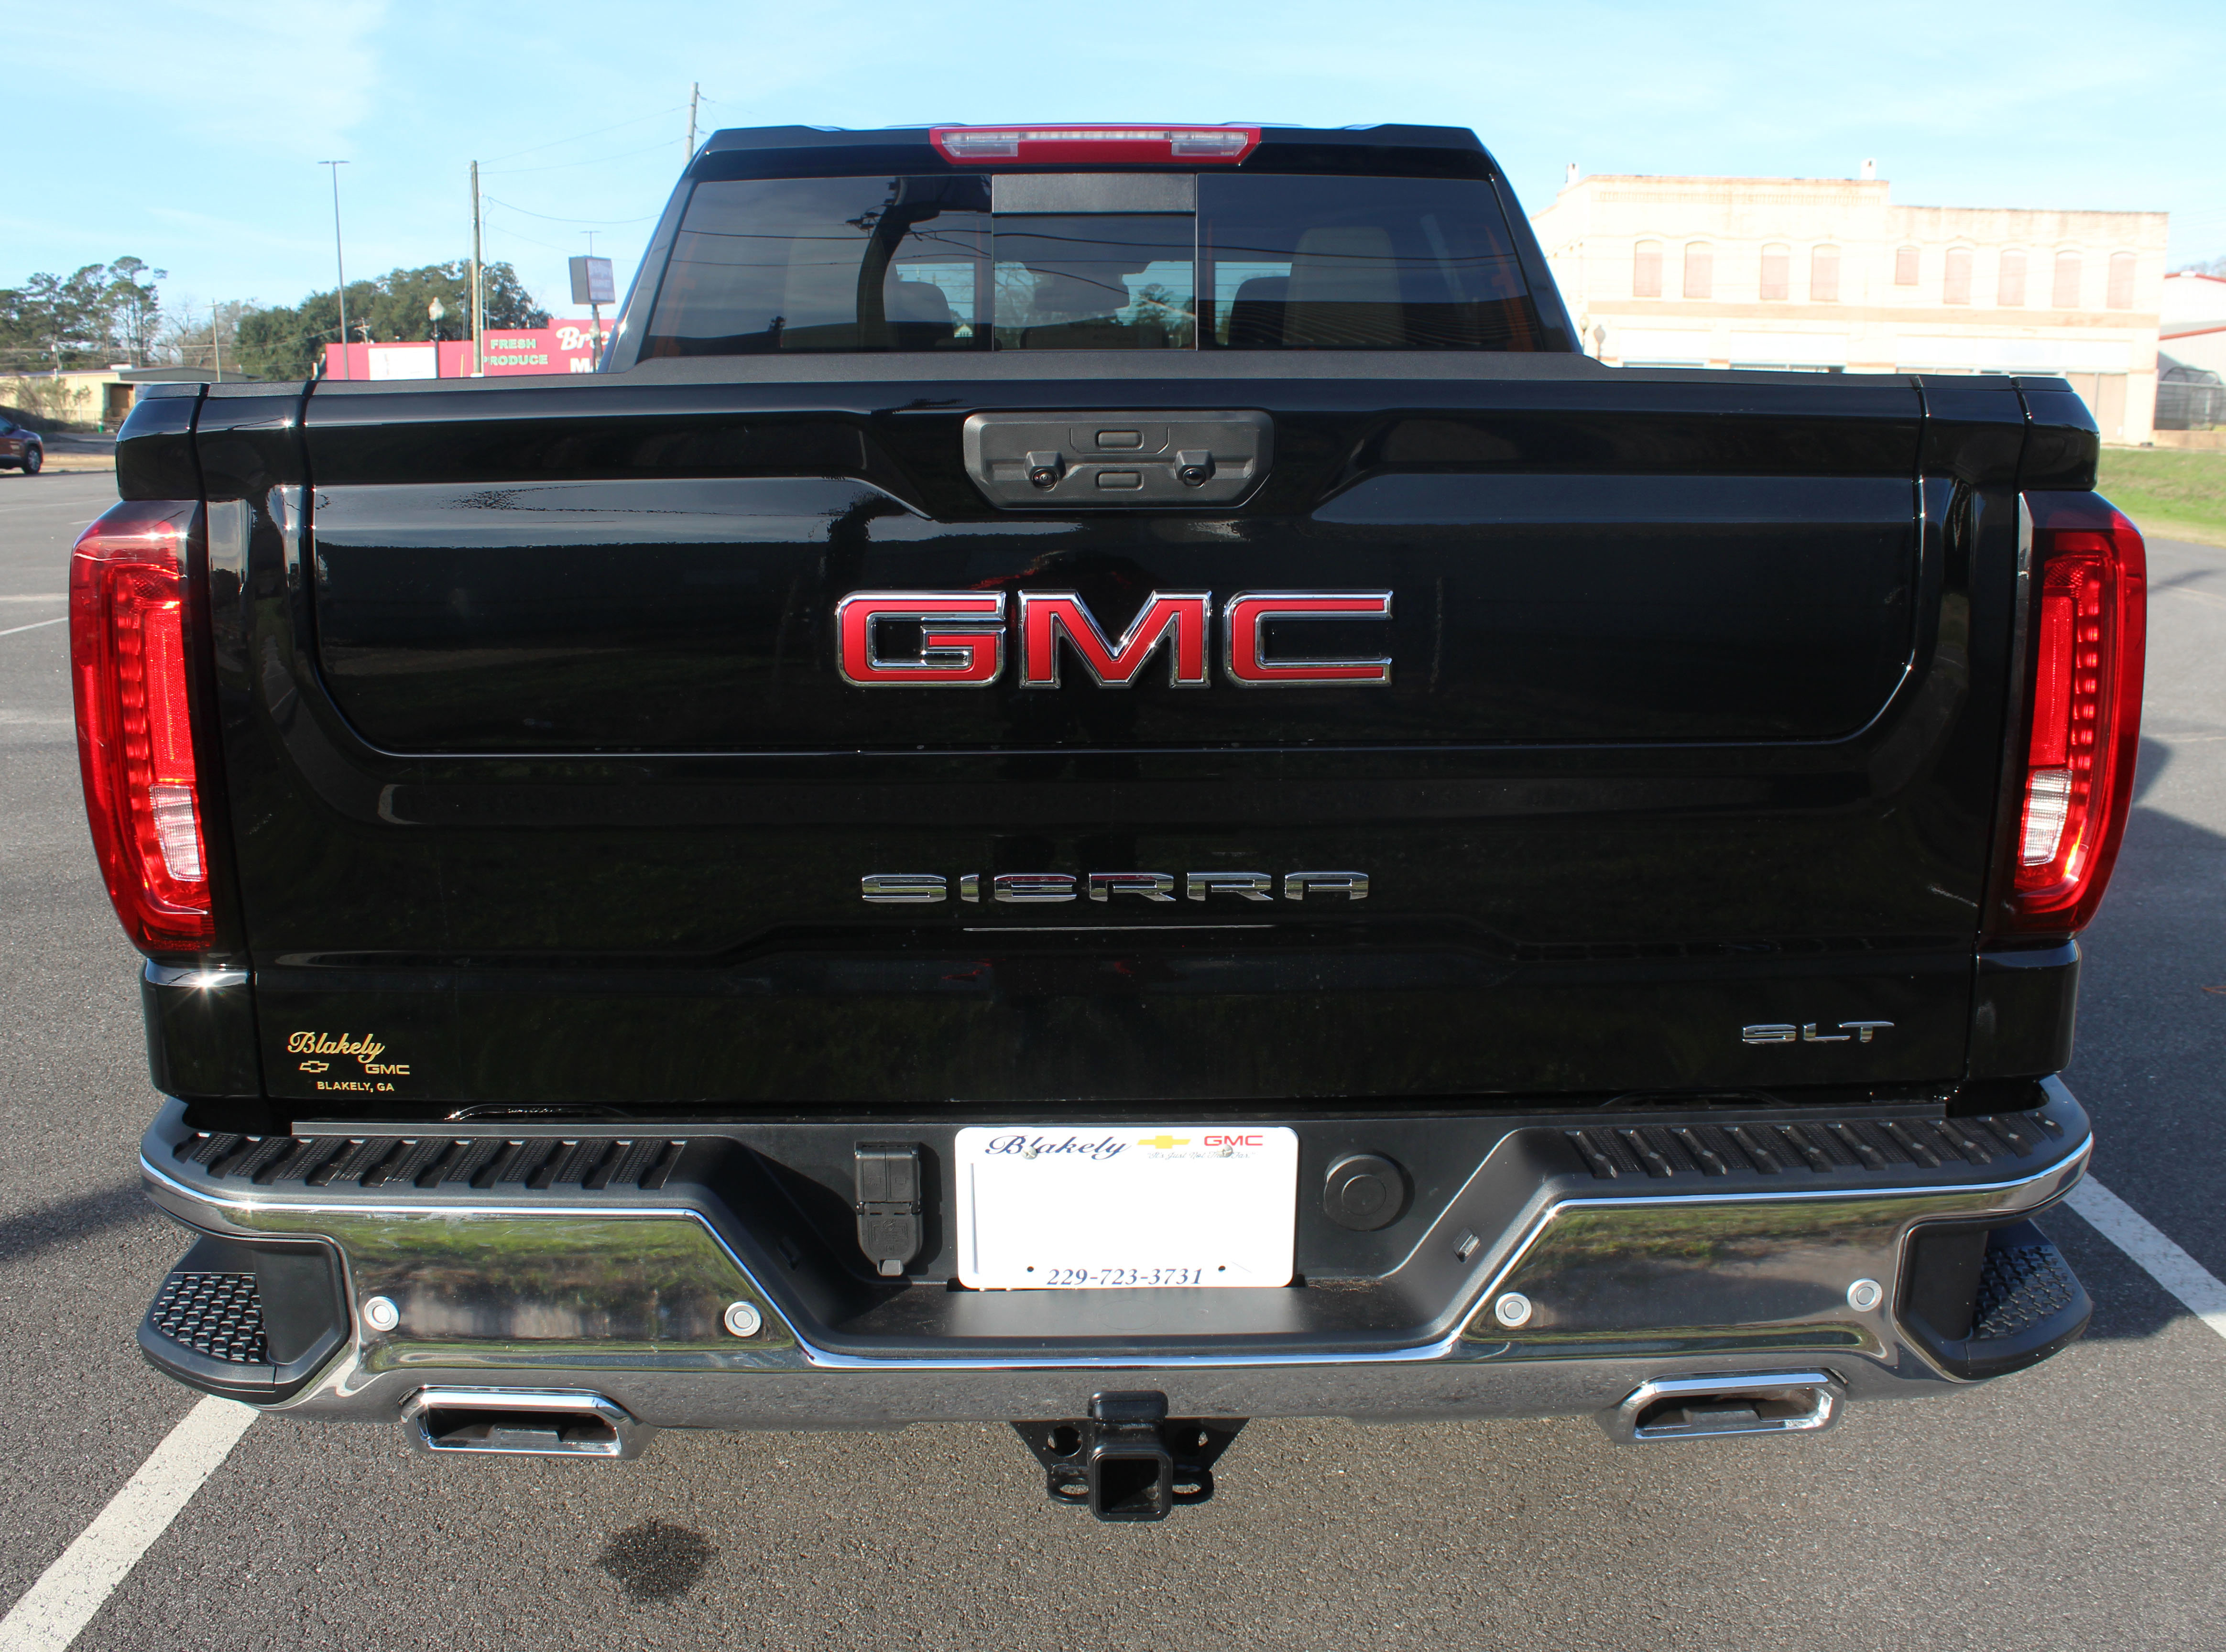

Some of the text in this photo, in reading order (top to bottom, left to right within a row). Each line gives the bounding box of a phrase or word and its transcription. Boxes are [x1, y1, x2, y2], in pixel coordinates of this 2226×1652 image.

[491, 338, 536, 349] FRESH
[483, 354, 549, 366] PRODUCE
[833, 589, 1394, 689] GMC
[861, 871, 1369, 902] SIERRA
[1742, 1021, 1895, 1044] SLT
[287, 1031, 385, 1064] Blakely
[365, 1064, 410, 1075] GMC
[316, 1081, 395, 1093] BLAKELY, GA
[985, 1135, 1132, 1160] Blakely
[1204, 1135, 1264, 1146] GMC
[1046, 1268, 1202, 1285] 229-723-3731
